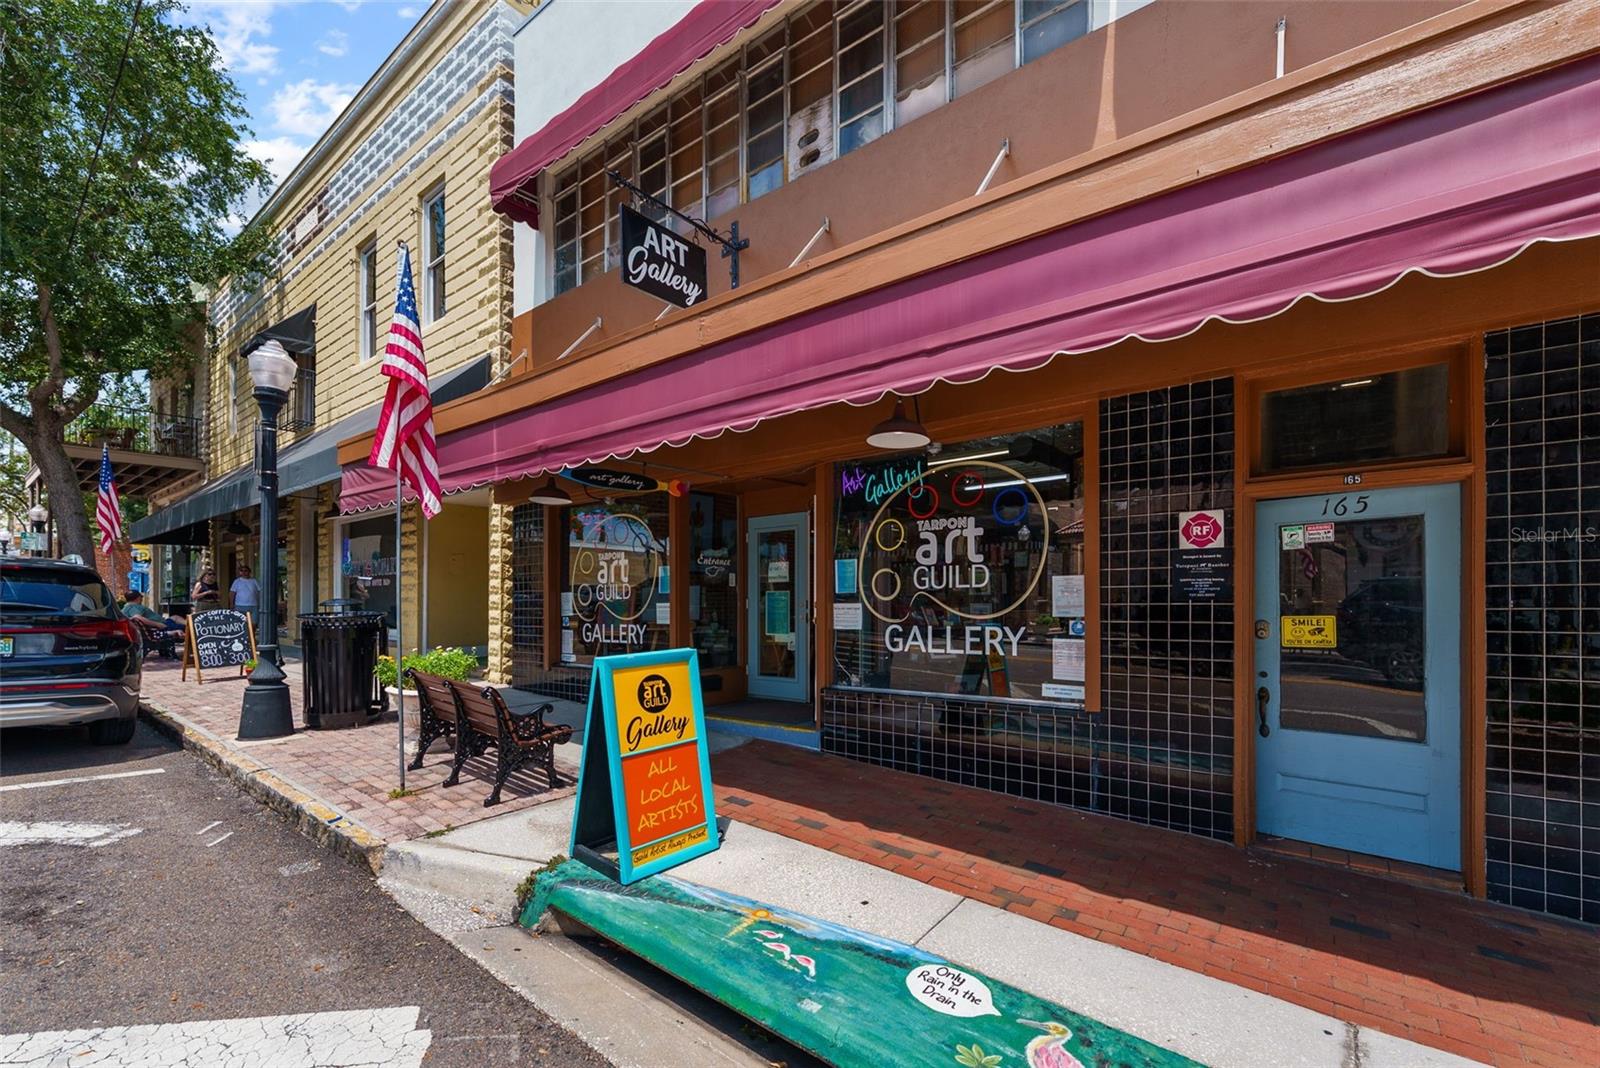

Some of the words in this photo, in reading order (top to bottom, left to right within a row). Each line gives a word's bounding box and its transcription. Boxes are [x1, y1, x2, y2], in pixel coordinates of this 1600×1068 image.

[643, 226, 689, 268] ART
[628, 245, 702, 306] Gallery
[608, 475, 645, 490] gallery
[842, 466, 867, 496] Art
[865, 460, 924, 505] Gallery
[1344, 475, 1361, 485] 165
[1321, 495, 1370, 517] 165
[917, 516, 967, 531] TARPON
[1192, 525, 1211, 536] RF
[915, 516, 984, 566] art
[597, 553, 630, 584] art
[697, 553, 732, 566] Entrance
[913, 564, 990, 590] GUILD
[596, 583, 631, 601] GUILD
[194, 622, 246, 636] POTIONARY
[1291, 618, 1326, 627] SMILE!
[582, 623, 647, 645] GALLERY
[884, 624, 1026, 657] GALLERY
[198, 642, 217, 650] OPEN
[643, 680, 667, 700] art
[643, 695, 669, 709] GUILD
[626, 714, 690, 752] Gallery
[648, 756, 678, 778] ALL
[640, 776, 691, 805] LOCAL
[638, 793, 698, 833] ARTISTS
[936, 966, 966, 987] Only
[917, 970, 946, 989] Rain
[947, 984, 960, 996] in
[962, 990, 983, 1006] the
[921, 984, 957, 1010] Drain
